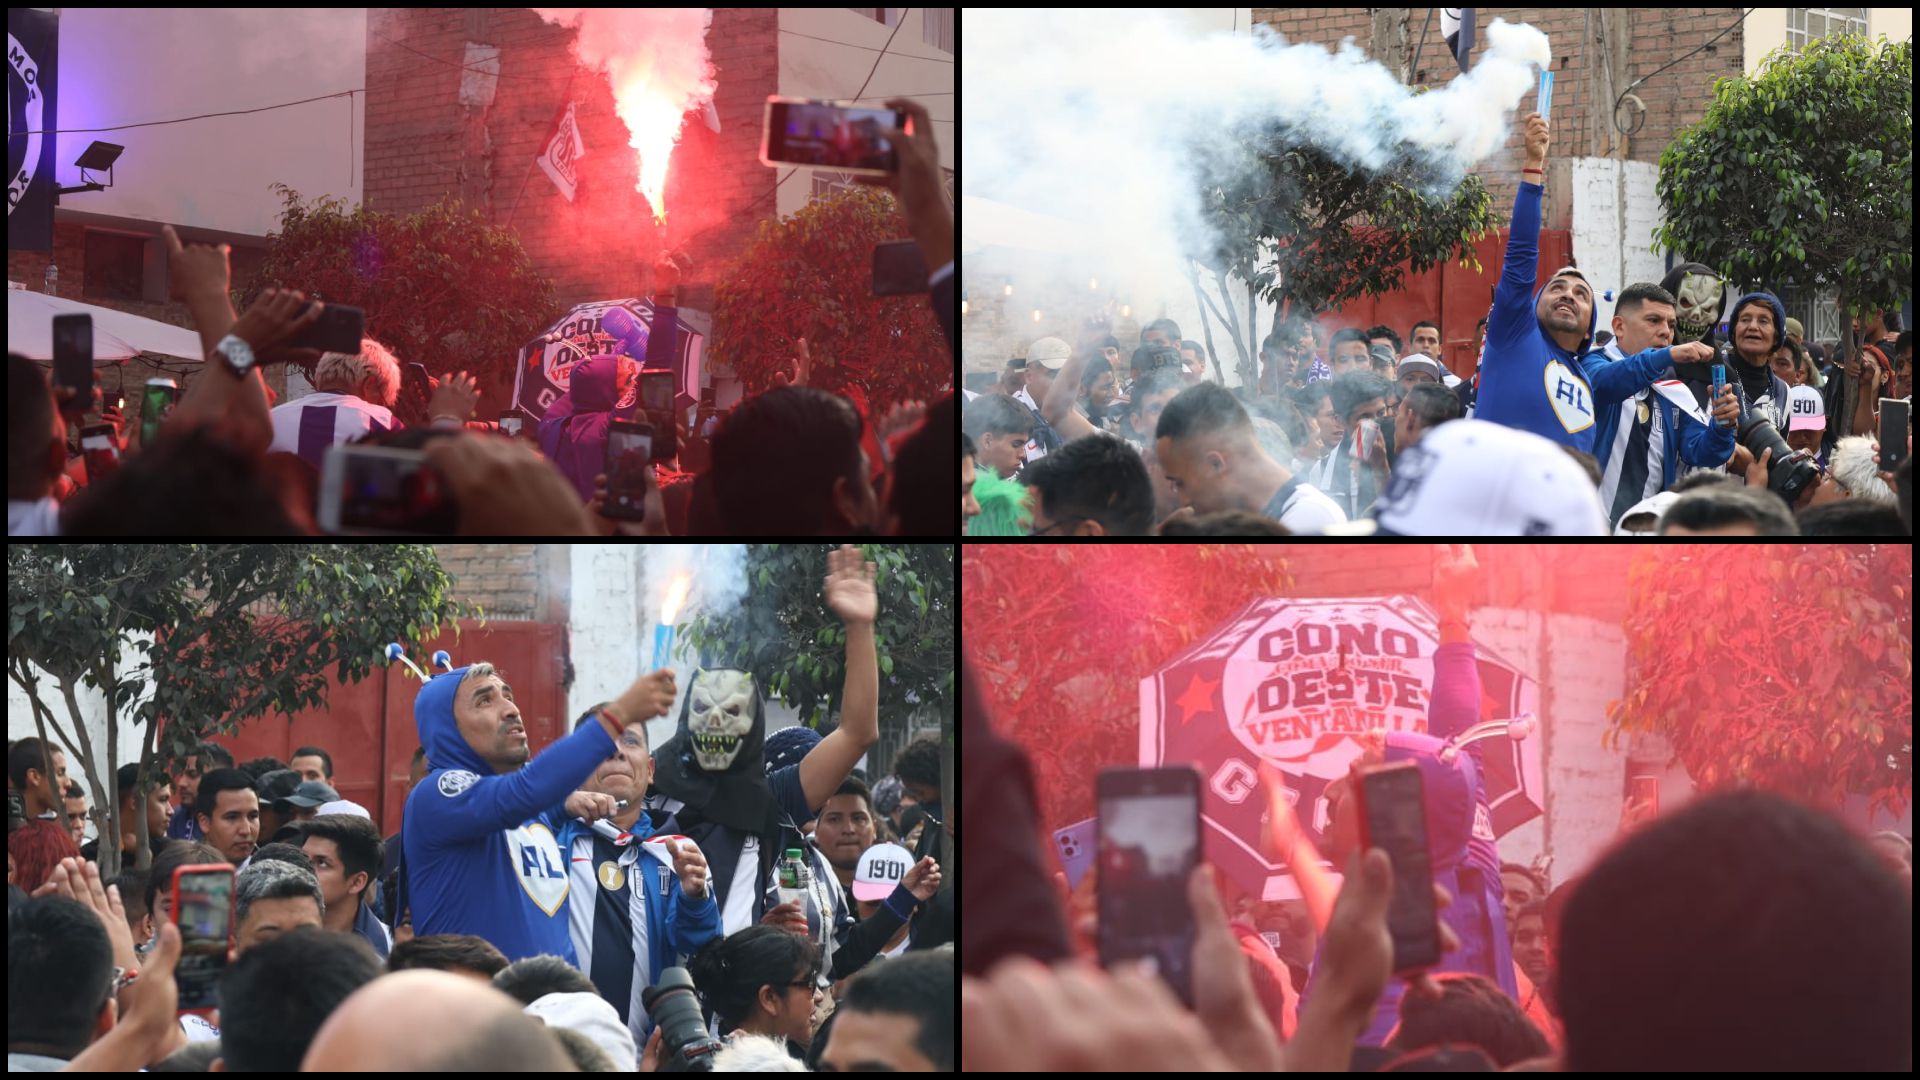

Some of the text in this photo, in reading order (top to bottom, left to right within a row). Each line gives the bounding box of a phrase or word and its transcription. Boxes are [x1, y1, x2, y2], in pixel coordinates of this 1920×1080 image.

[1556, 376, 1591, 417] AL
[1258, 622, 1420, 663] CONO
[1257, 668, 1426, 714] OESTE
[520, 842, 564, 879] AL
